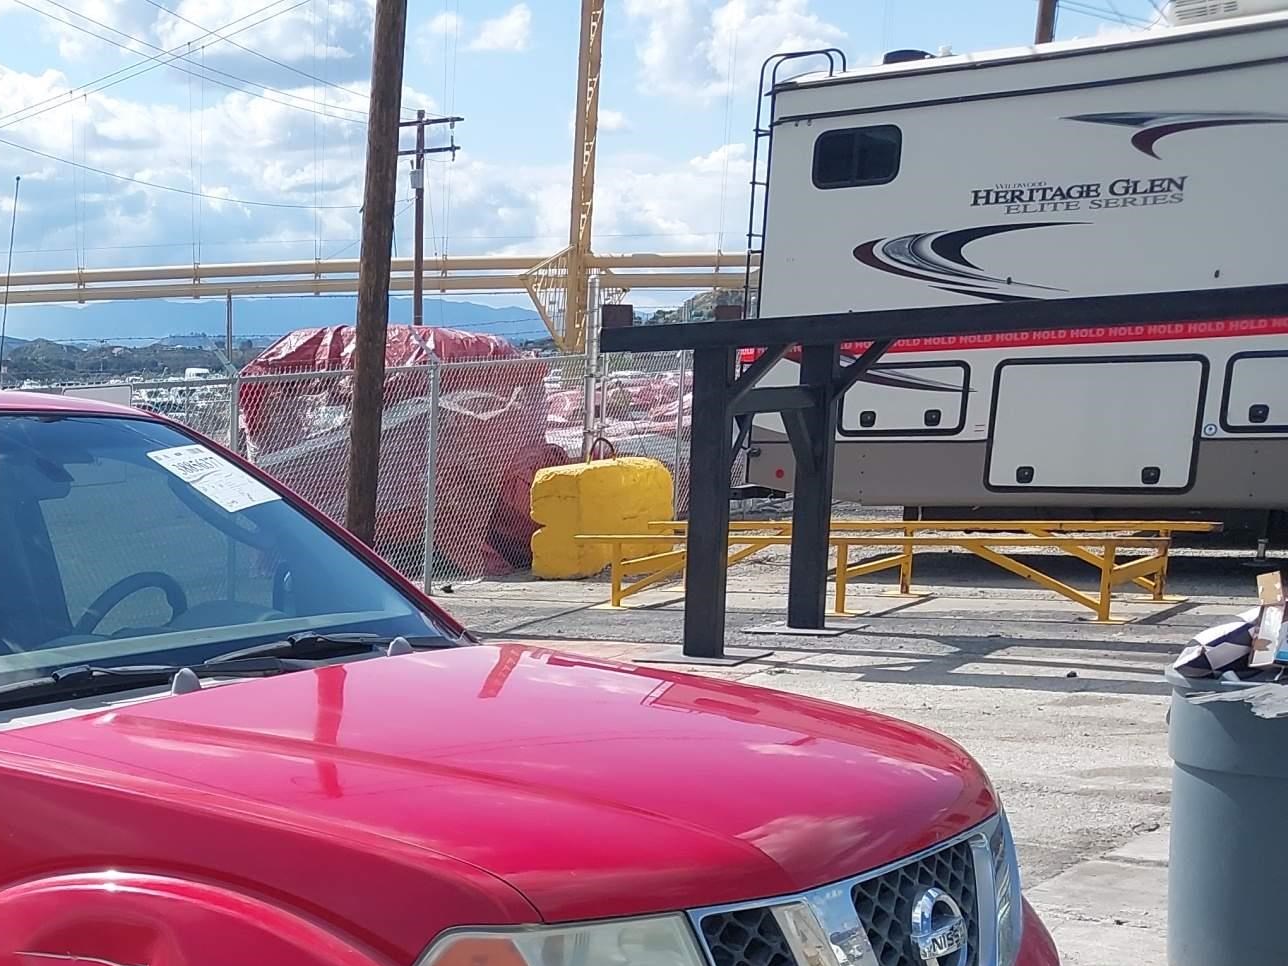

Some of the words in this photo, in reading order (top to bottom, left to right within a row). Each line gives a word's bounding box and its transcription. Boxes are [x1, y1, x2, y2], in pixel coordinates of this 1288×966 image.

[970, 183, 1101, 206] HERITAGE
[1109, 176, 1188, 196] GLEN
[1005, 200, 1081, 215] ELITE
[1088, 192, 1184, 210] SERIES
[924, 336, 956, 345] HOLD
[959, 334, 992, 344] HOLD
[996, 332, 1029, 342] HOLD
[1032, 330, 1066, 340] HOLD
[1070, 328, 1105, 338] HOLD
[1108, 326, 1144, 336] HOLD
[1147, 324, 1184, 334] HOLD
[1188, 321, 1225, 333] HOLD
[1229, 319, 1268, 331] HOLD
